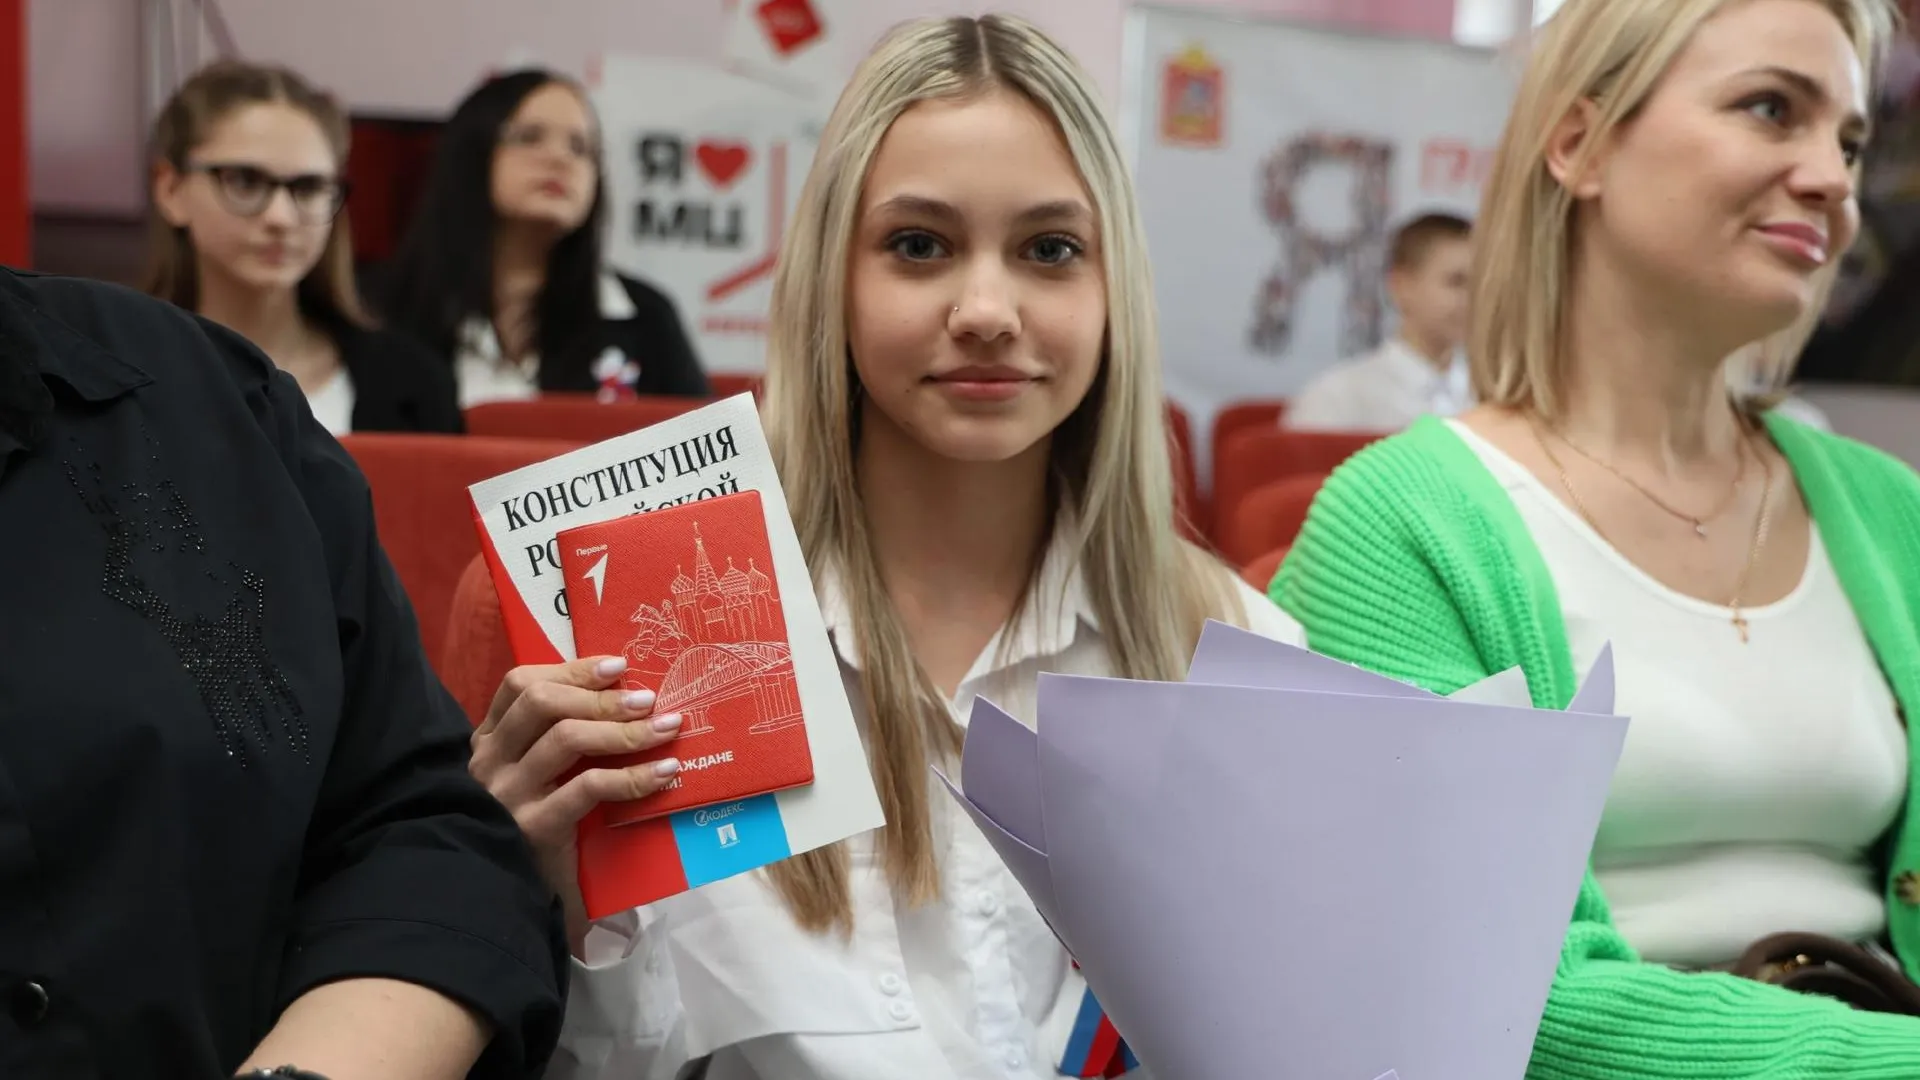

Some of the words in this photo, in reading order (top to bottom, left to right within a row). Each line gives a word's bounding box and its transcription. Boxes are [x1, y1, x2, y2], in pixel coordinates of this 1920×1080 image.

[637, 132, 682, 187] Я
[1251, 132, 1392, 358] Я
[501, 425, 740, 532] КОНСТИТУЦИЯ
[576, 544, 608, 556] Первые
[676, 750, 734, 773] АЖДАНЕ
